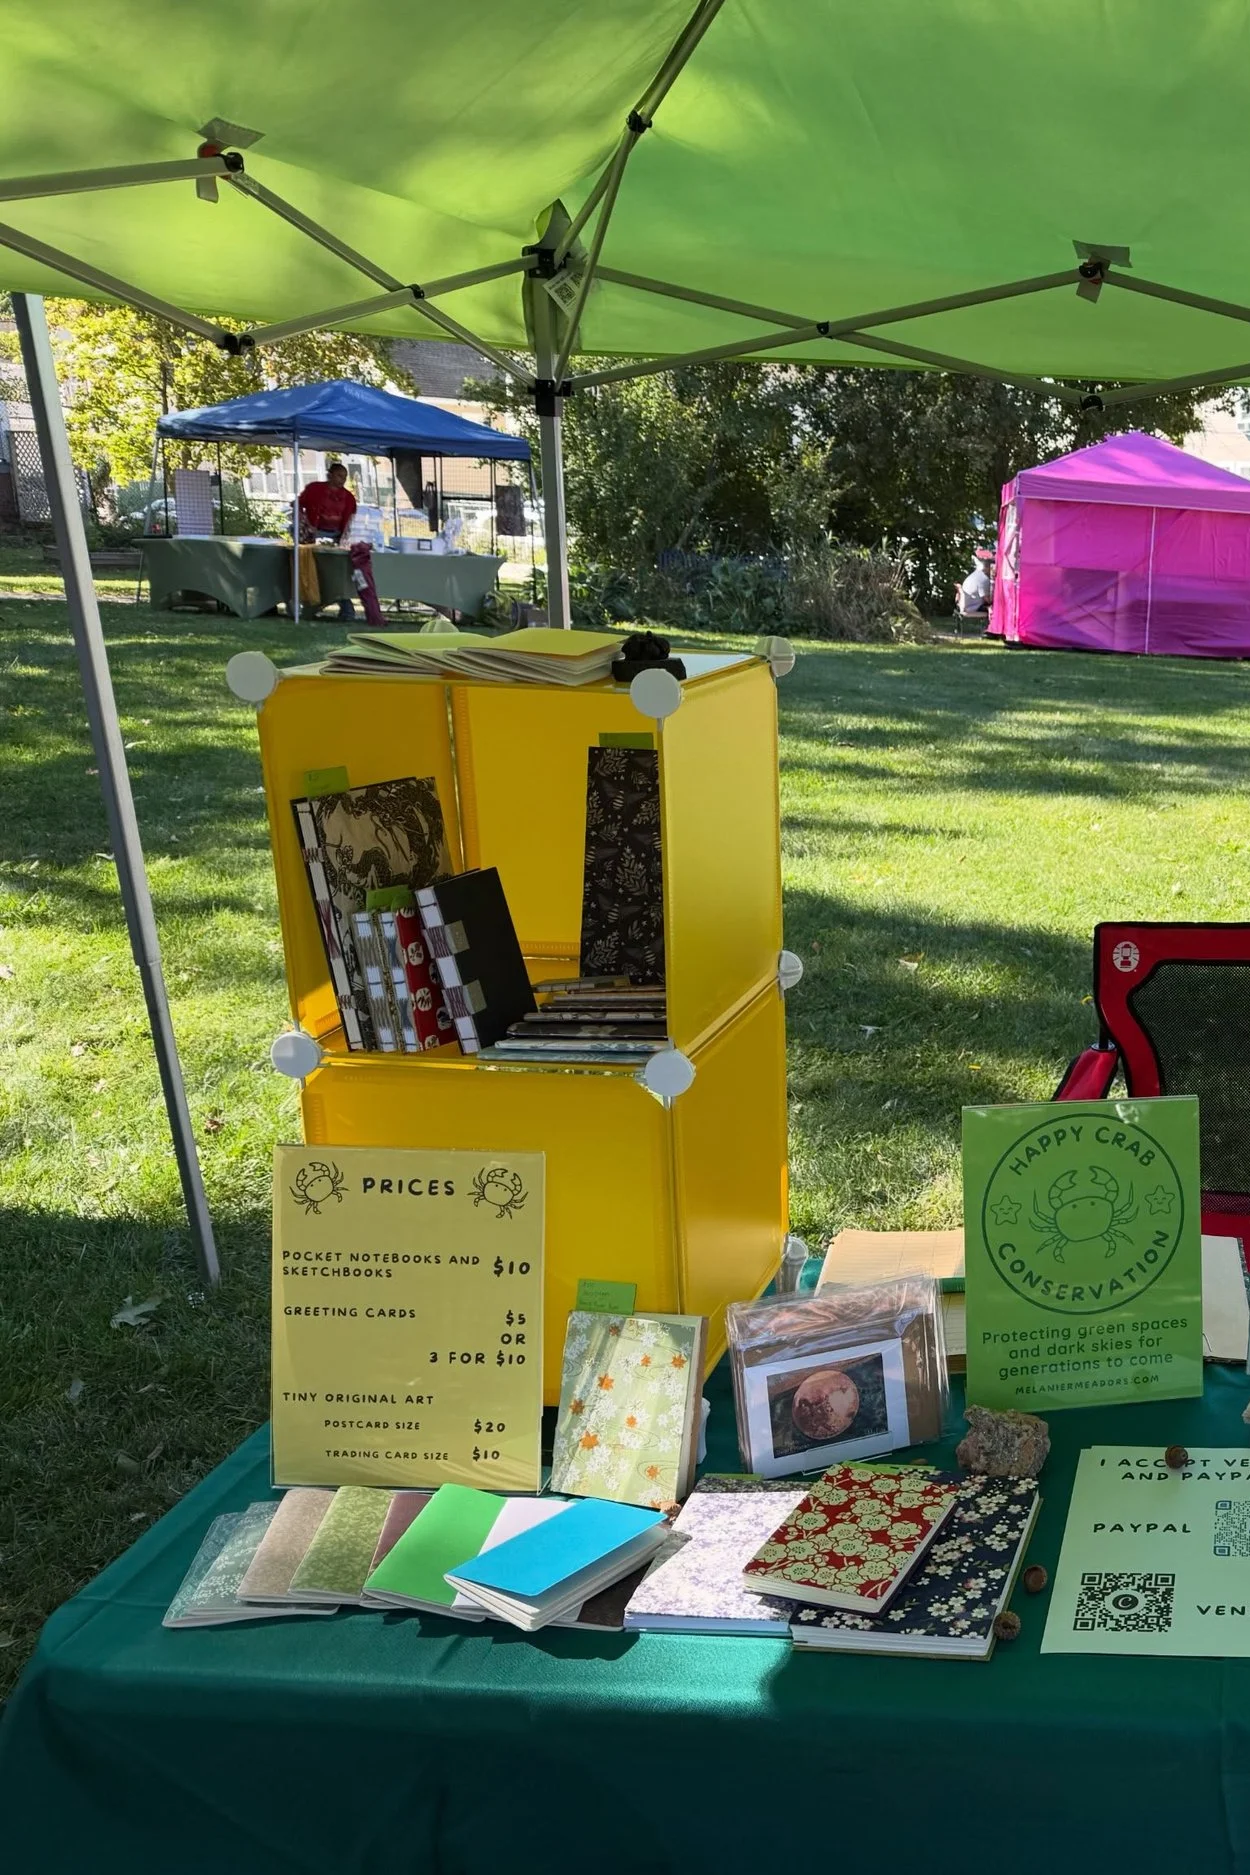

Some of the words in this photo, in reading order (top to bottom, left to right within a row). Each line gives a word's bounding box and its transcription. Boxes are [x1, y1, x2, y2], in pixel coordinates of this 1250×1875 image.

[1009, 1125, 1084, 1176] HAPPY
[1095, 1126, 1156, 1168] CRAB
[362, 1176, 456, 1196] PRICES
[282, 1250, 342, 1262] POCKET
[350, 1252, 442, 1264] NOTEBOOKS
[449, 1255, 481, 1266] AND
[997, 1229, 1171, 1301] CONSERVATION
[282, 1265, 393, 1278] SKETCHBOOKS
[493, 1256, 530, 1277] $10
[283, 1306, 359, 1318] GREETING
[365, 1307, 416, 1319] CARDS
[505, 1310, 526, 1327] $5
[982, 1325, 1072, 1345] Protecting
[1078, 1323, 1126, 1340] green
[1131, 1317, 1188, 1334] spaces
[500, 1333, 526, 1345] OR
[1009, 1346, 1041, 1359] and
[1047, 1341, 1086, 1357] dark
[1091, 1338, 1132, 1353] skies
[1138, 1334, 1163, 1349] for
[429, 1352, 438, 1364] 3
[449, 1352, 486, 1365] FOR
[496, 1350, 526, 1367] $10
[998, 1359, 1100, 1381] generations
[1106, 1355, 1124, 1368] to
[1128, 1352, 1173, 1366] come
[1015, 1374, 1159, 1395] MELANIERMEADORS.COM
[282, 1392, 318, 1402] TINY
[324, 1393, 397, 1405] ORIGINAL
[404, 1395, 434, 1405] ART
[324, 1419, 389, 1430] POSTCARD
[395, 1421, 421, 1431] SIZE
[474, 1419, 506, 1434] $20
[325, 1450, 379, 1459] TRADING
[385, 1450, 417, 1460] CARD
[424, 1451, 449, 1461] SIZE
[472, 1447, 500, 1462] $10
[1100, 1459, 1106, 1467] I
[1118, 1458, 1211, 1469] ACCPT
[1121, 1471, 1169, 1481] AND
[1093, 1523, 1192, 1534] PAYPAL
